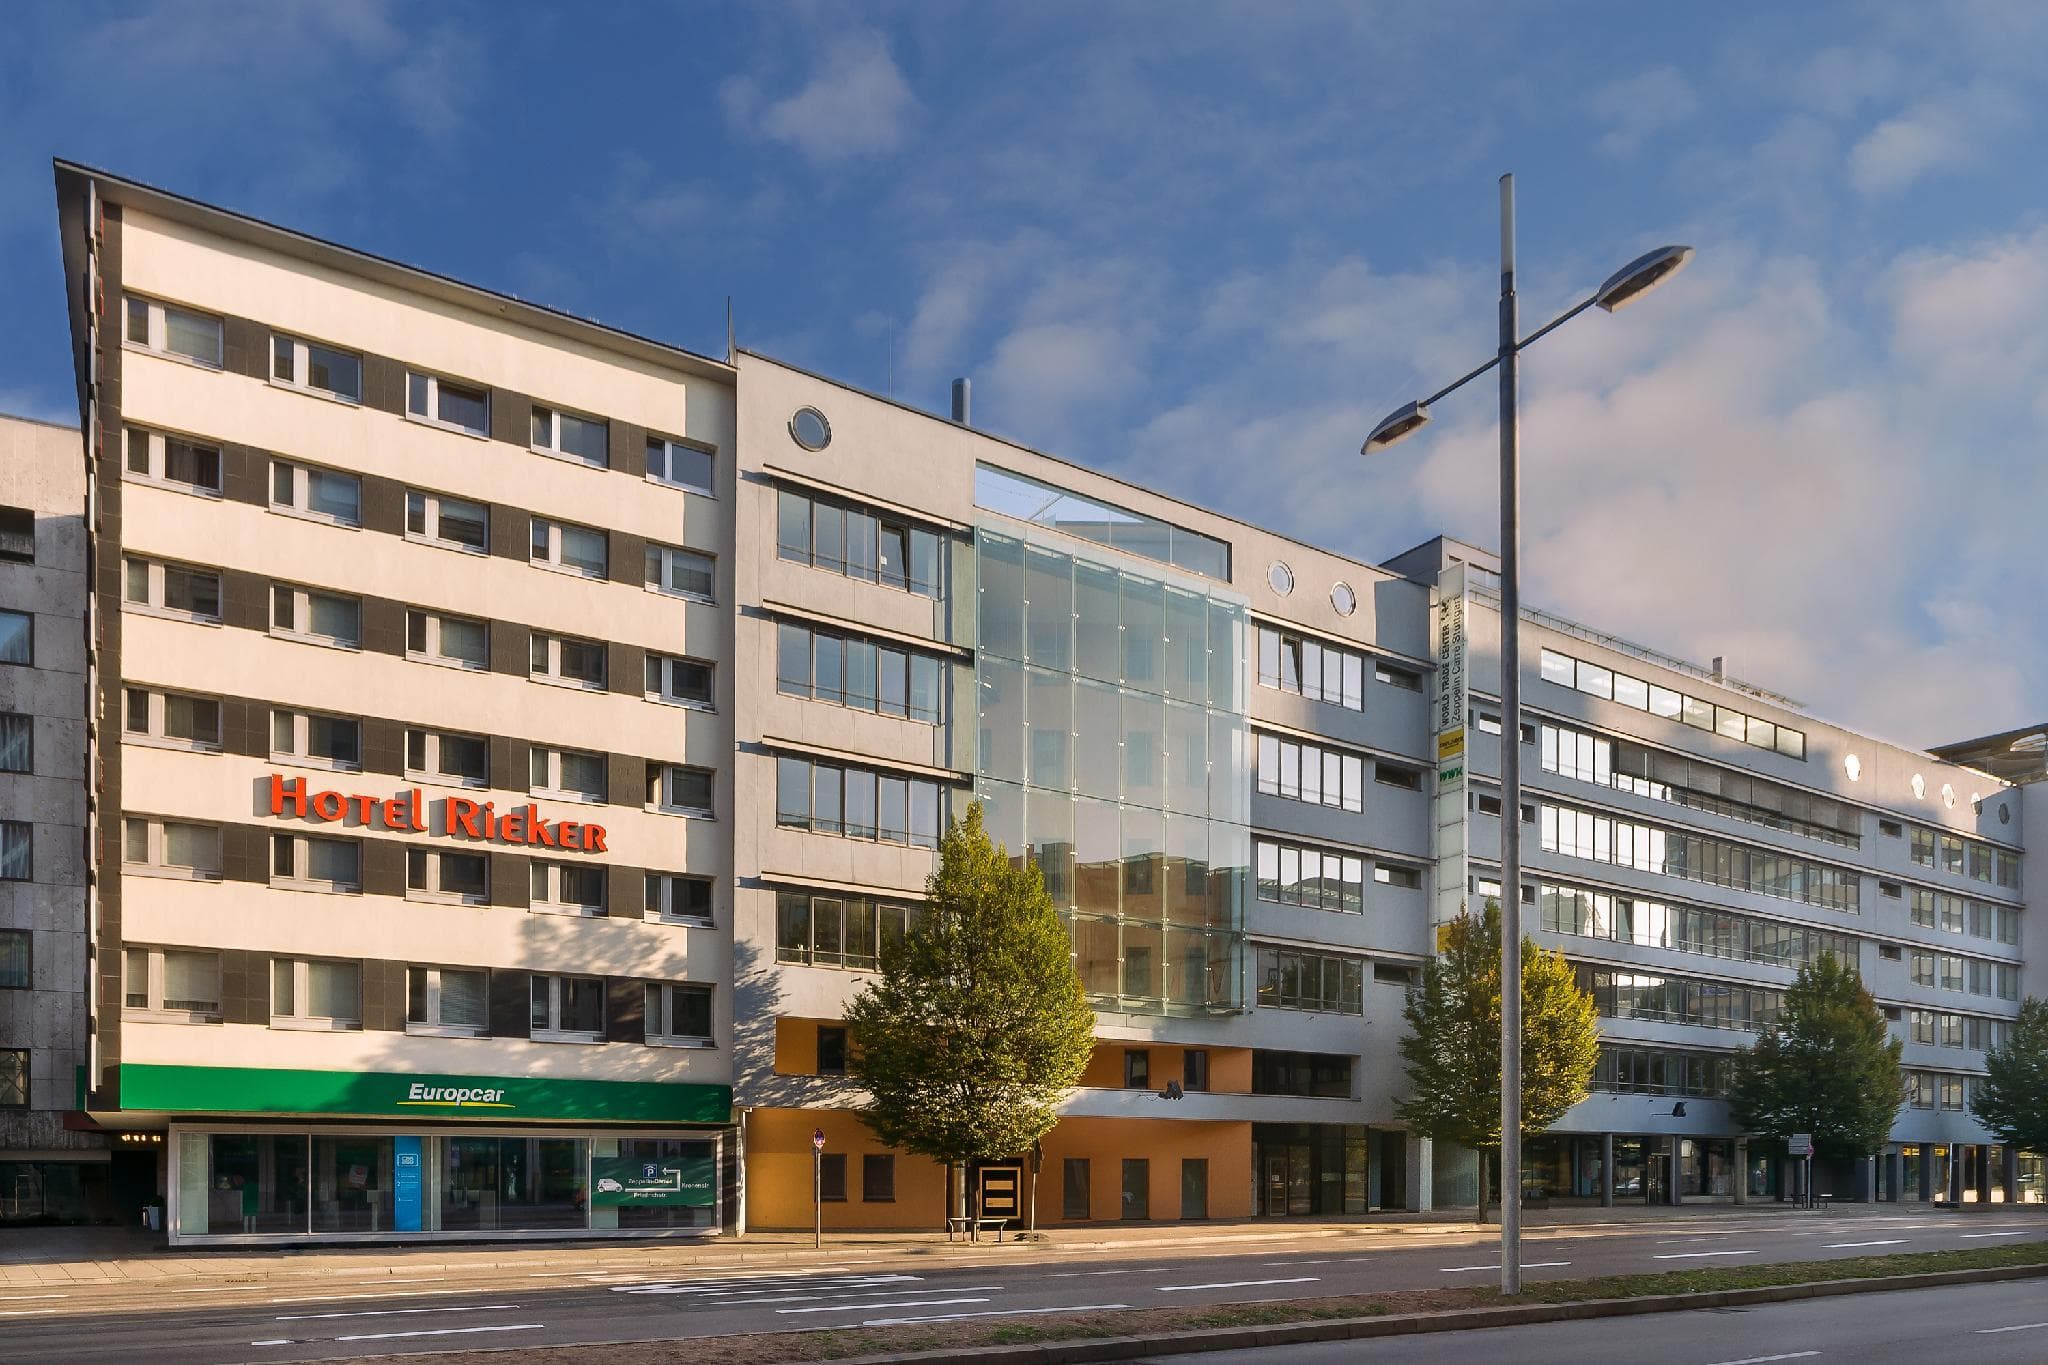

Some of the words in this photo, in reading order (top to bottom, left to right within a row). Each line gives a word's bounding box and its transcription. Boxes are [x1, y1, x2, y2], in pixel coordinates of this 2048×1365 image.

[1451, 594, 1463, 644] Stuttgart
[1441, 623, 1450, 660] CENTER
[1441, 662, 1450, 692] TRADE
[1441, 694, 1450, 727] WORLD
[1451, 678, 1462, 722] Zeppelin
[408, 1083, 505, 1107] Europcar
